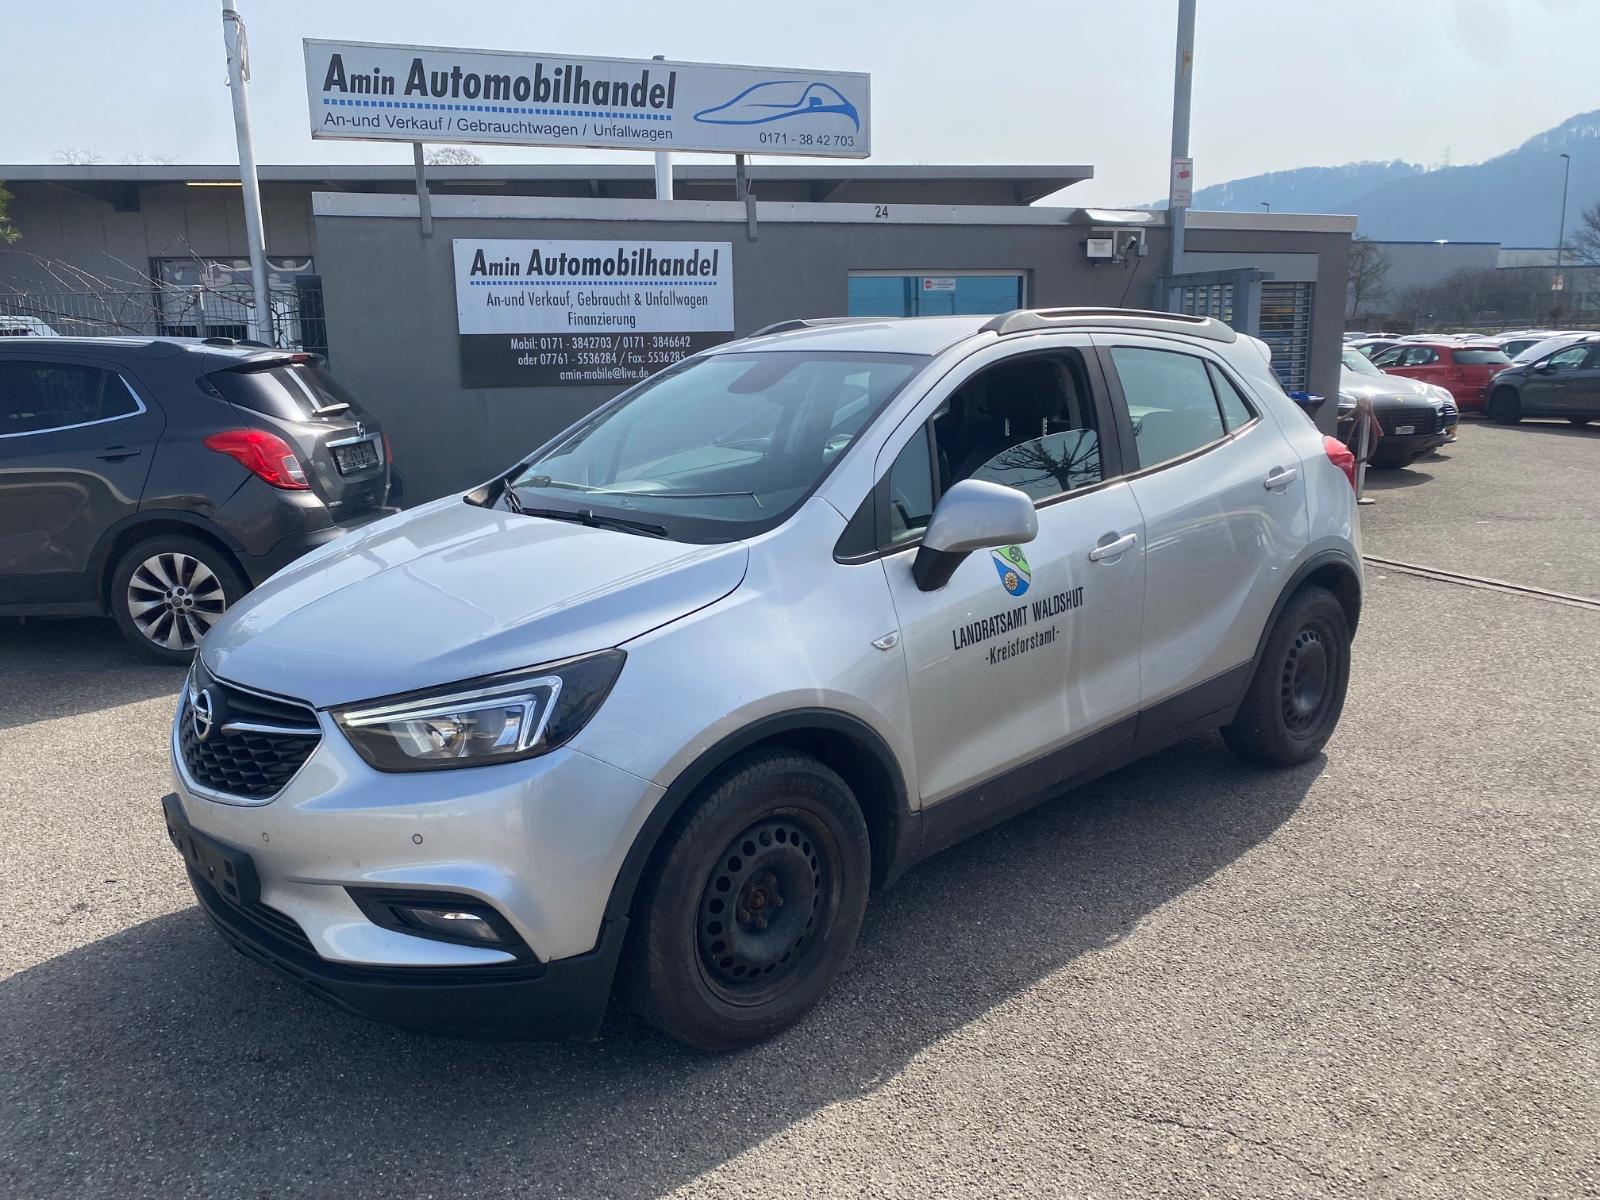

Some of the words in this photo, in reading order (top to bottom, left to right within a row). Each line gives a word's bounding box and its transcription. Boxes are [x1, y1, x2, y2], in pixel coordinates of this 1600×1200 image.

[323, 53, 395, 95] Amin
[404, 58, 677, 109] Automobilhandel
[324, 112, 380, 127] An-und
[385, 115, 444, 131] Verkauf
[457, 118, 578, 139] Gebrauchtwagen
[594, 124, 673, 142] Unfallwagen
[759, 132, 787, 145] 0171
[799, 134, 813, 145] 38
[816, 135, 830, 146] 42
[834, 135, 854, 147] 703
[875, 205, 889, 218] 24
[470, 249, 520, 276] Amin
[526, 248, 719, 277] Automobilhandel
[486, 291, 525, 306] An-und
[528, 291, 573, 308] Verkauf,
[577, 291, 631, 306] Gebraucht
[634, 294, 642, 306] &
[645, 291, 708, 309] Unfallwagen
[568, 312, 636, 328] Finanzierung
[510, 337, 538, 350] Mobil:
[540, 337, 562, 350] 0171
[572, 336, 612, 349] 3842703
[623, 336, 645, 349] 0171
[652, 335, 691, 348] 3846642
[518, 352, 538, 366] oder
[540, 352, 568, 365] 07761
[577, 351, 617, 365] 5536284
[628, 351, 645, 364] Fax:
[560, 366, 649, 380] amin-mobile@live.de
[952, 606, 1028, 651] LANDRATSAMT
[1032, 587, 1084, 622] WALDSHUT
